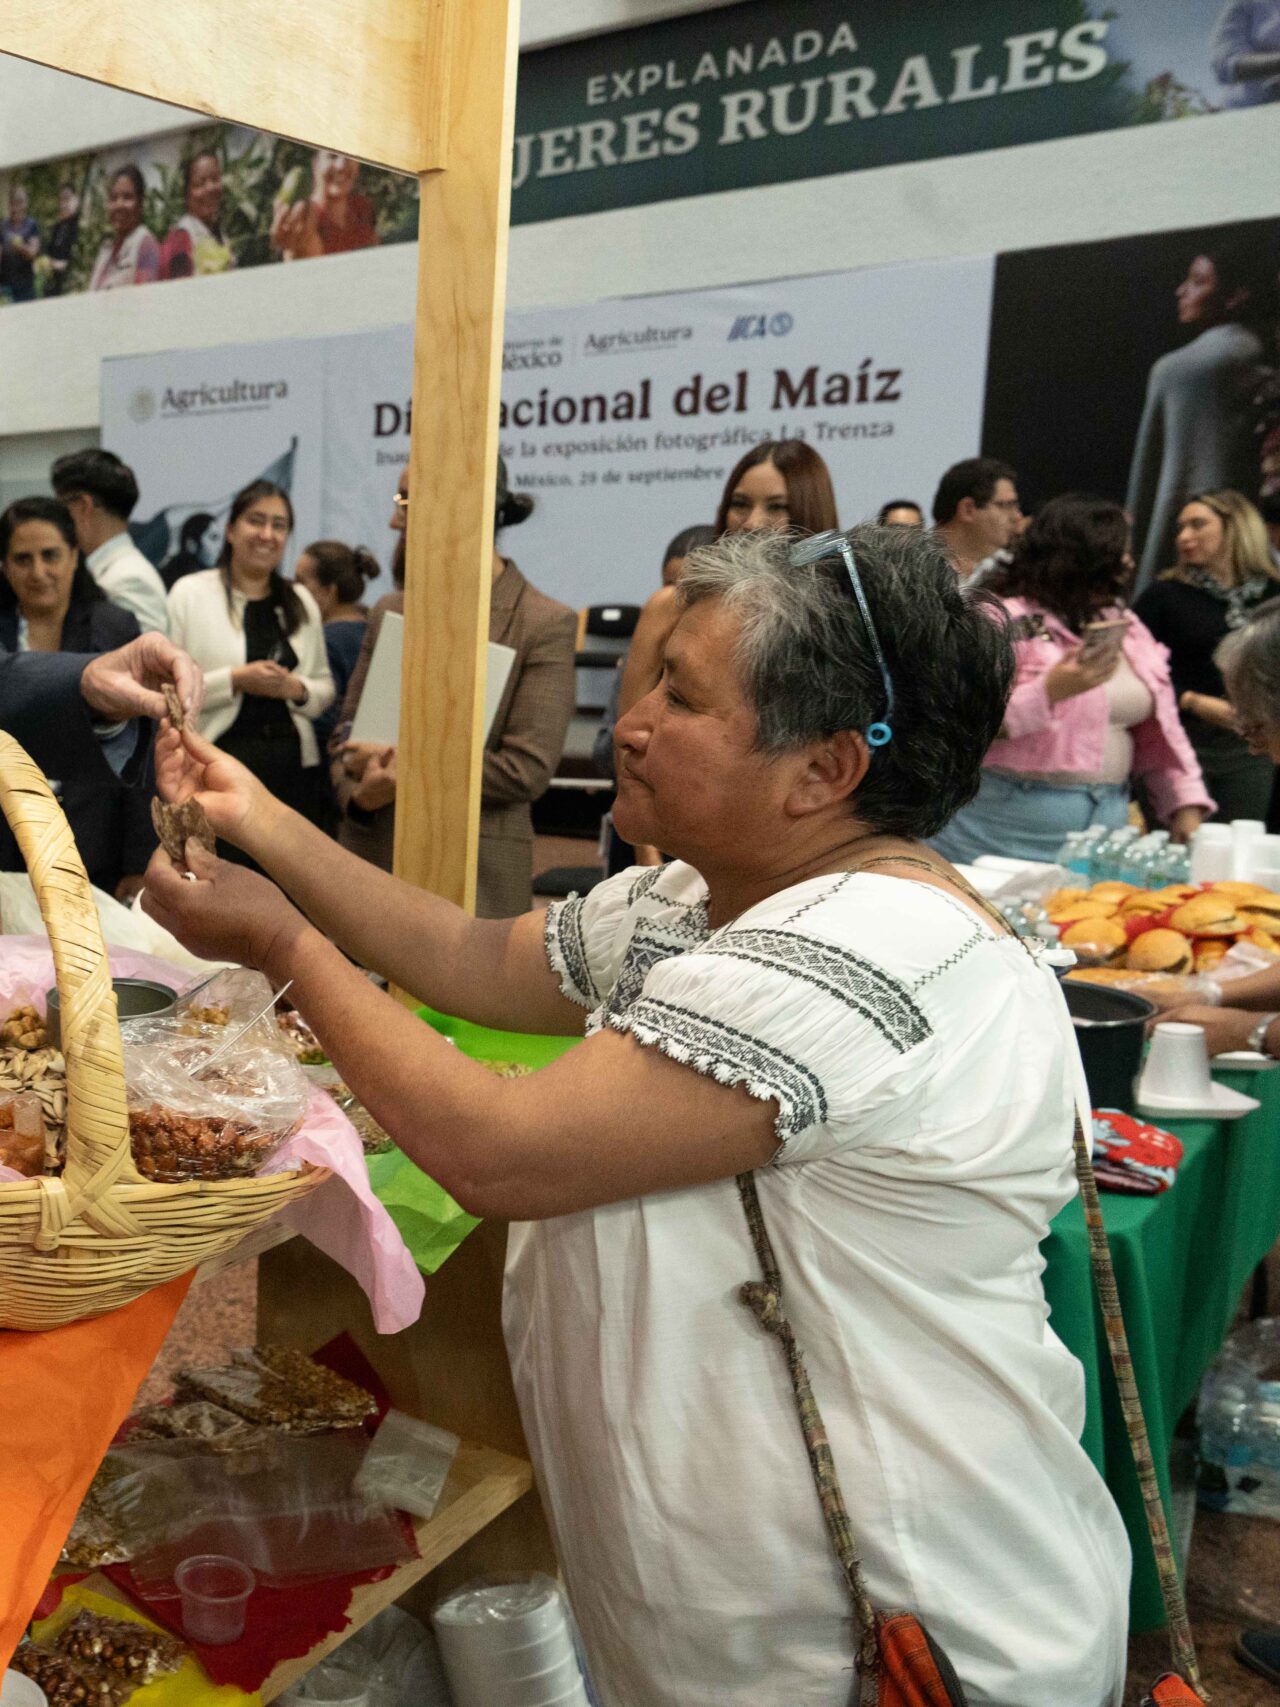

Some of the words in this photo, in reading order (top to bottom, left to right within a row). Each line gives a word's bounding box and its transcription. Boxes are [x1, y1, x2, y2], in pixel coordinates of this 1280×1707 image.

[586, 22, 858, 106] EXPLANADA
[511, 102, 701, 190] JERES
[718, 20, 1108, 145] RURALES
[583, 325, 693, 350] Agricultura
[502, 350, 563, 371] éxico
[160, 378, 289, 413] Agricultura
[374, 397, 412, 438] Dí
[500, 378, 651, 429] cional
[673, 369, 749, 416] del
[771, 357, 902, 411] Maíz
[542, 430, 648, 460] exposición
[655, 423, 773, 453] fotográfica
[815, 419, 895, 442] Trenza
[602, 468, 621, 484] de
[628, 465, 725, 485] septiembre
